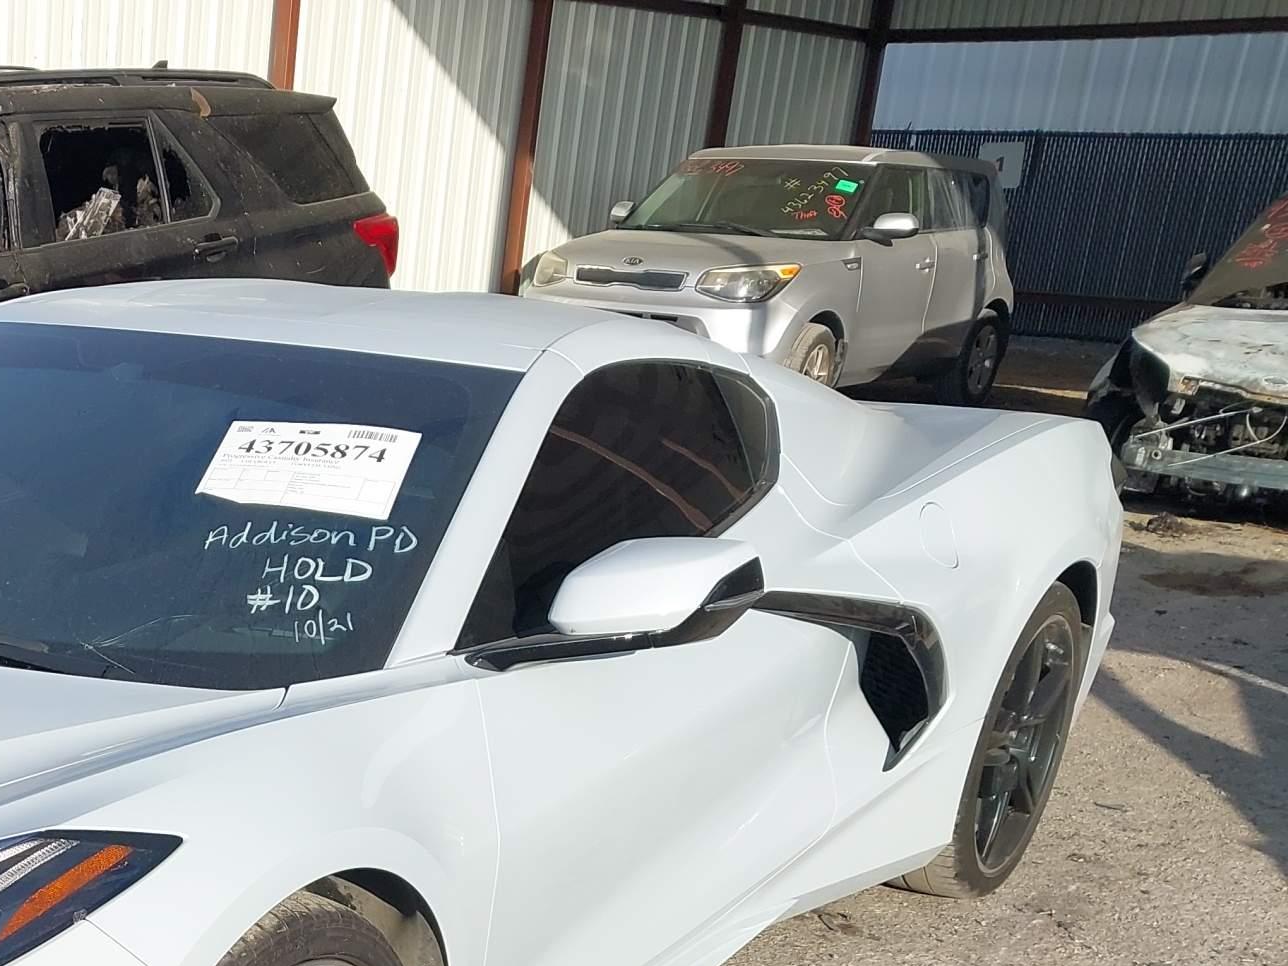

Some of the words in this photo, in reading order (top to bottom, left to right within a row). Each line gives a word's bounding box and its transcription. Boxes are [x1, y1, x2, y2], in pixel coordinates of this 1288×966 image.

[238, 438, 387, 463] 43705874
[204, 521, 356, 550] Addison
[367, 526, 418, 553] PD
[262, 554, 373, 582] HOLD
[293, 609, 354, 645] 10/21
